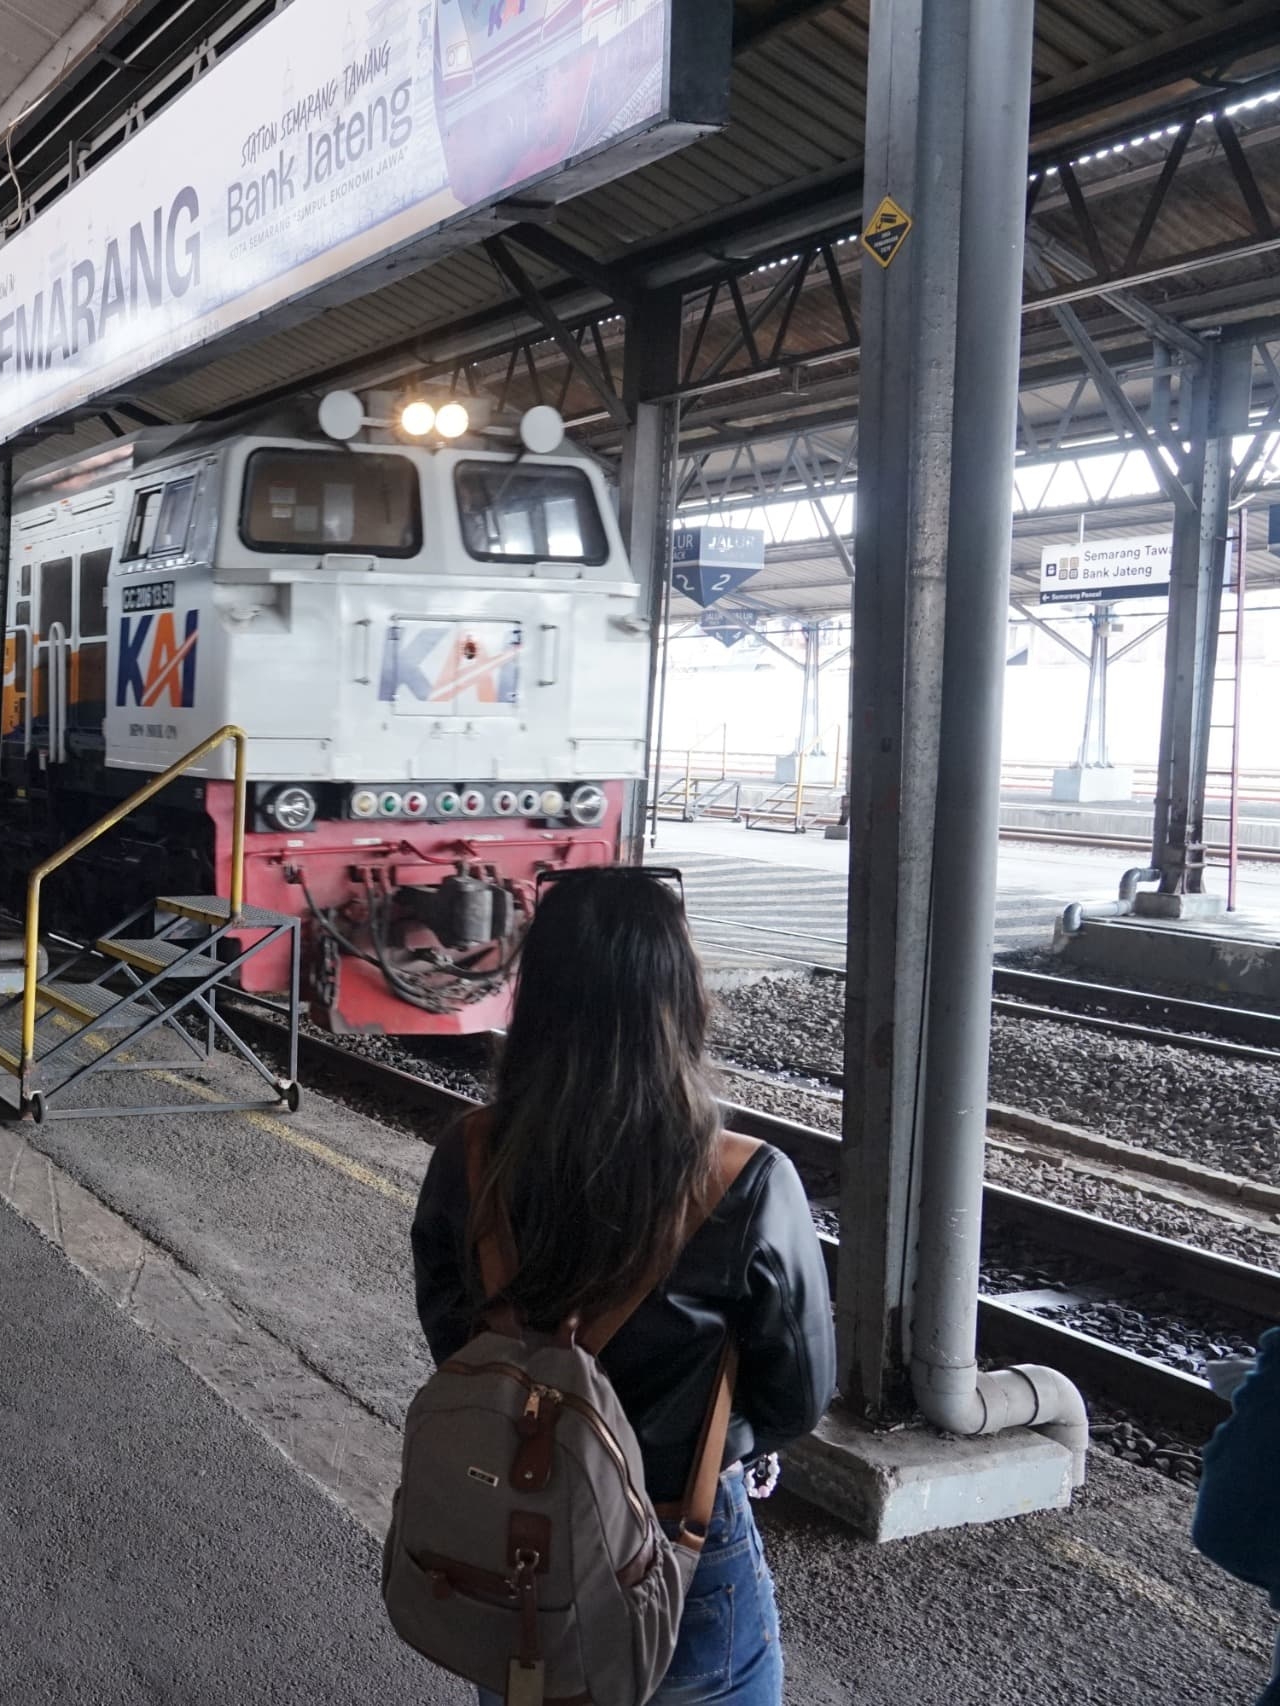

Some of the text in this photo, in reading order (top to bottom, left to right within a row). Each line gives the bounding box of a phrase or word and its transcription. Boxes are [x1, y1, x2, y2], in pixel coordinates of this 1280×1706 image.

[241, 39, 392, 169] STATION SEMARANG TAWANG
[227, 76, 413, 238] Bank Jateng
[249, 217, 291, 252] SEMARANG
[329, 170, 374, 204] EKONOMI
[676, 574, 695, 591] 2
[711, 574, 732, 591] 2
[1082, 566, 1153, 579] Bank Jateng
[1083, 549, 1141, 562] Semarang
[116, 609, 199, 708] KAI
[378, 627, 522, 703] KAI
